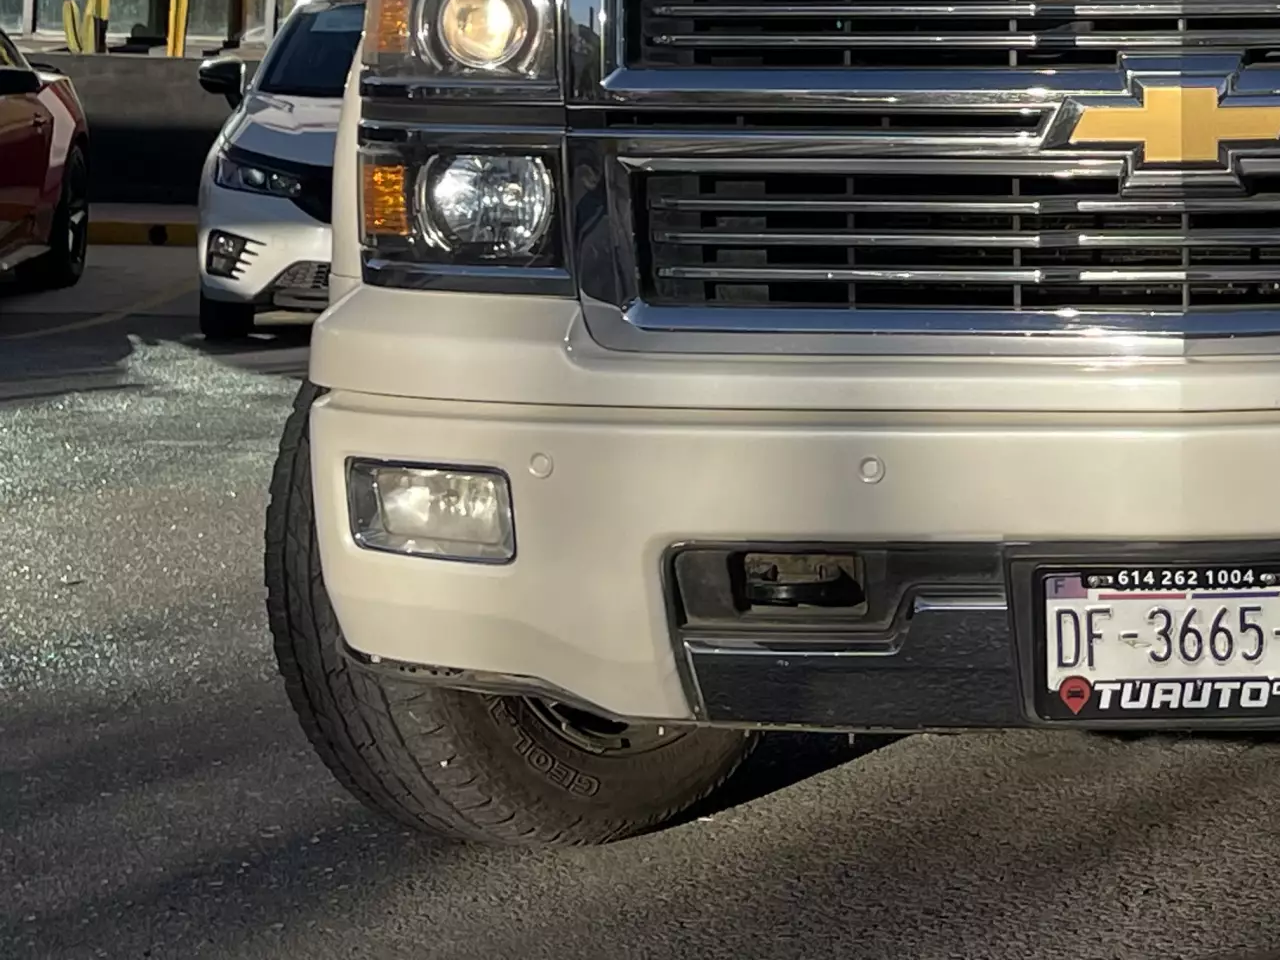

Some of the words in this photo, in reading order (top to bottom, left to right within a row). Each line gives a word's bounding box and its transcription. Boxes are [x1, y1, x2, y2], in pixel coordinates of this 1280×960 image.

[1117, 570, 1155, 586] 614
[1161, 570, 1199, 585] 262
[1205, 570, 1255, 585] 1004
[1093, 681, 1271, 709] TUAUTO
